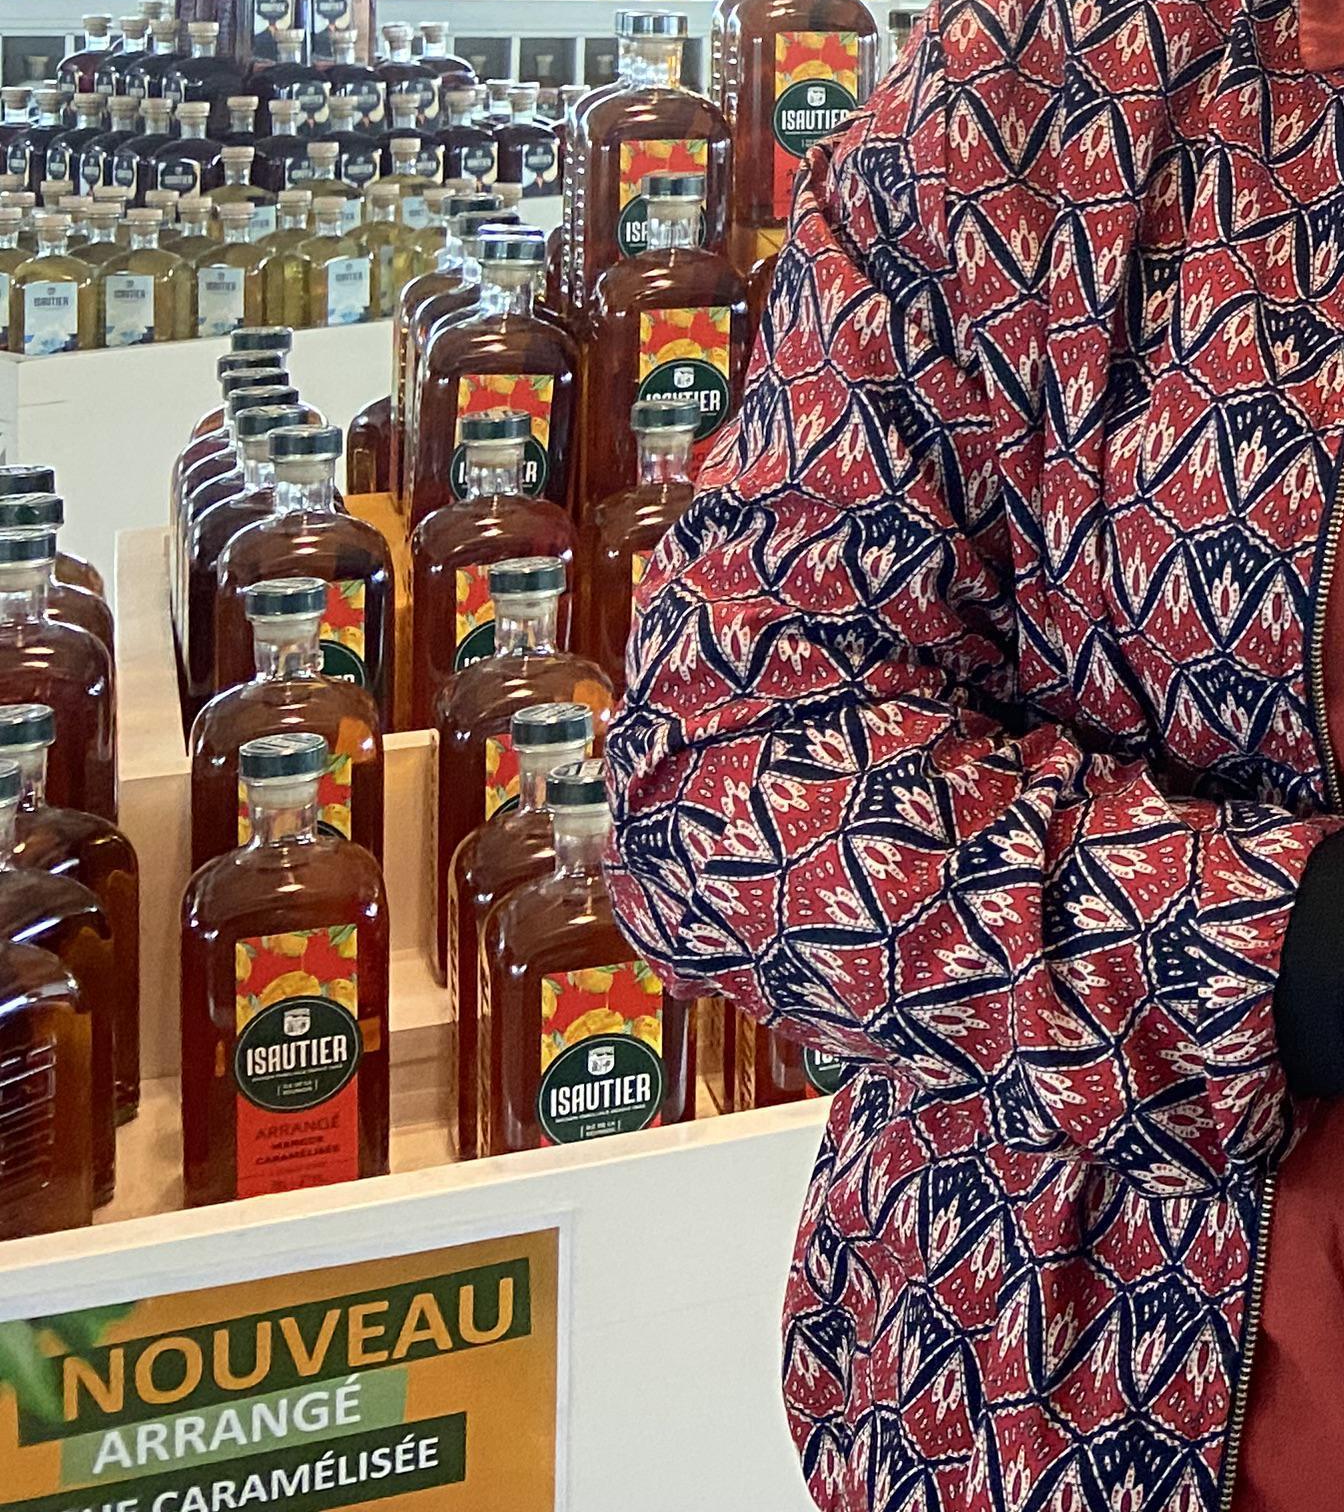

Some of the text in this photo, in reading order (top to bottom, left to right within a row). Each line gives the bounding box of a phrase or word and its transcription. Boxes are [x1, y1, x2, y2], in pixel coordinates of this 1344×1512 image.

[246, 1035, 348, 1076] ISAUTIER
[550, 1073, 651, 1118] ISAUTIER
[63, 1277, 514, 1421] NOUVEAU
[92, 1374, 362, 1474] ARRANGÉ
[152, 1436, 439, 1512] CARAMÉLISÉE
